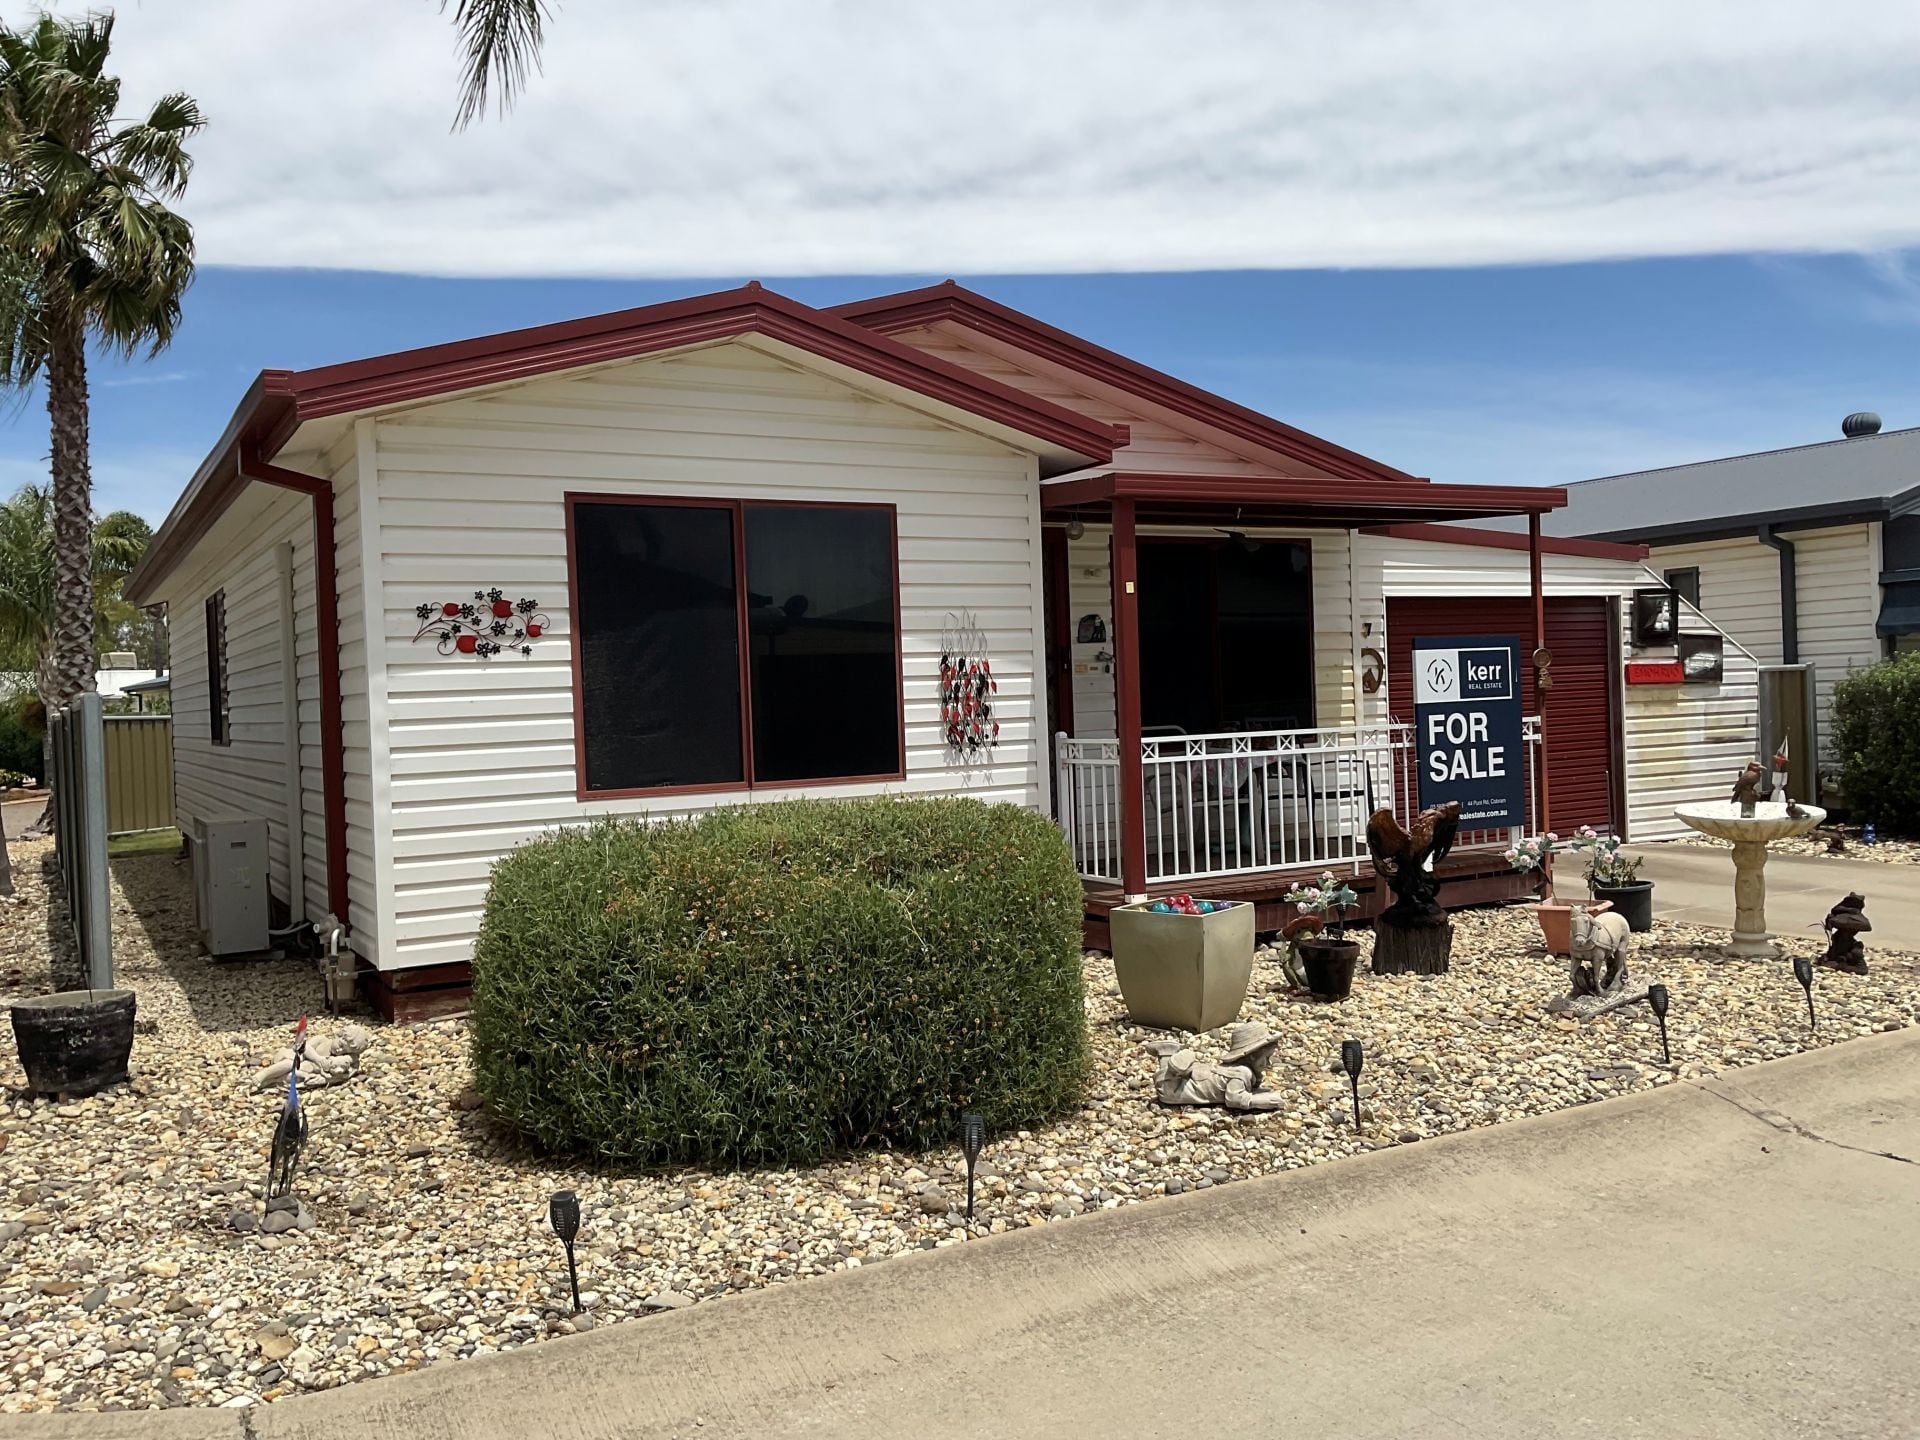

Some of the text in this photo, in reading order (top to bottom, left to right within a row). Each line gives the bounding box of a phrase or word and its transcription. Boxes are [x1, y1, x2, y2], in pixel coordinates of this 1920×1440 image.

[1467, 659, 1502, 681] kerr
[1428, 712, 1489, 745] FOR
[1429, 746, 1506, 782] SALE
[1458, 809, 1508, 820] realestate.com.au
